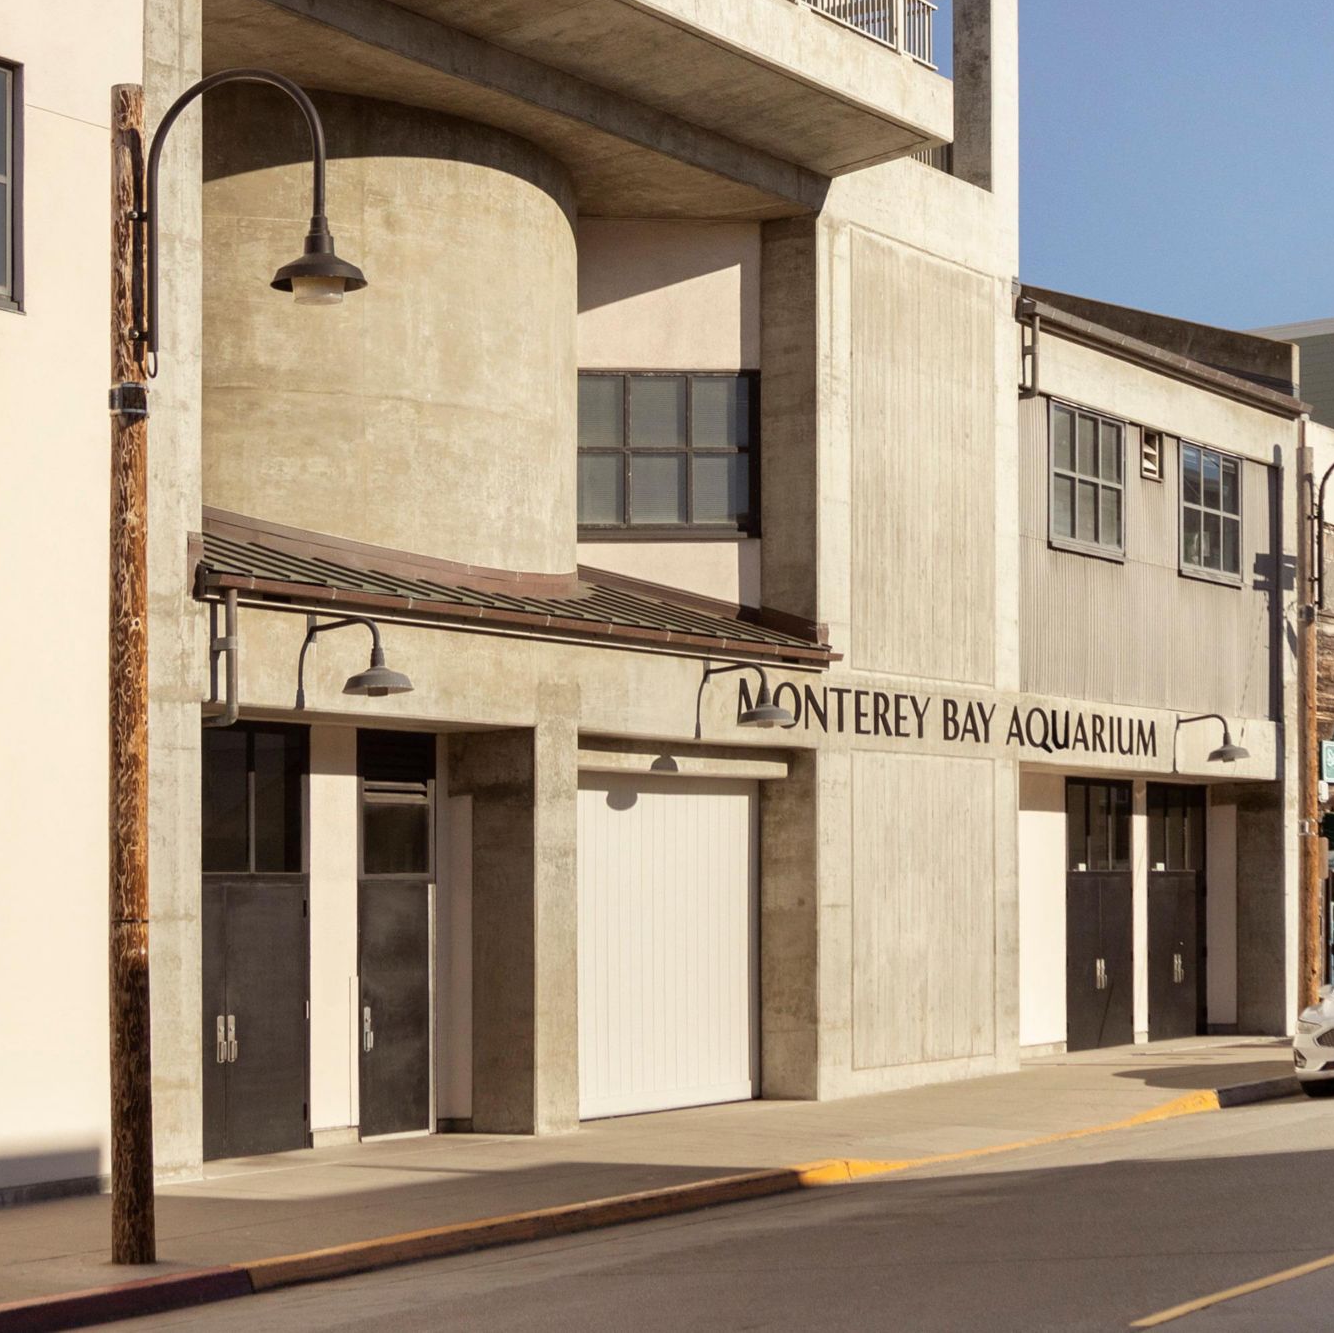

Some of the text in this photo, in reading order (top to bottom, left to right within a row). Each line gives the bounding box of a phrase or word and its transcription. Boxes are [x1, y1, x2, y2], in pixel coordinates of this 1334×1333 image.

[737, 677, 1157, 758] MONTEREY BAY AQUARIUM
